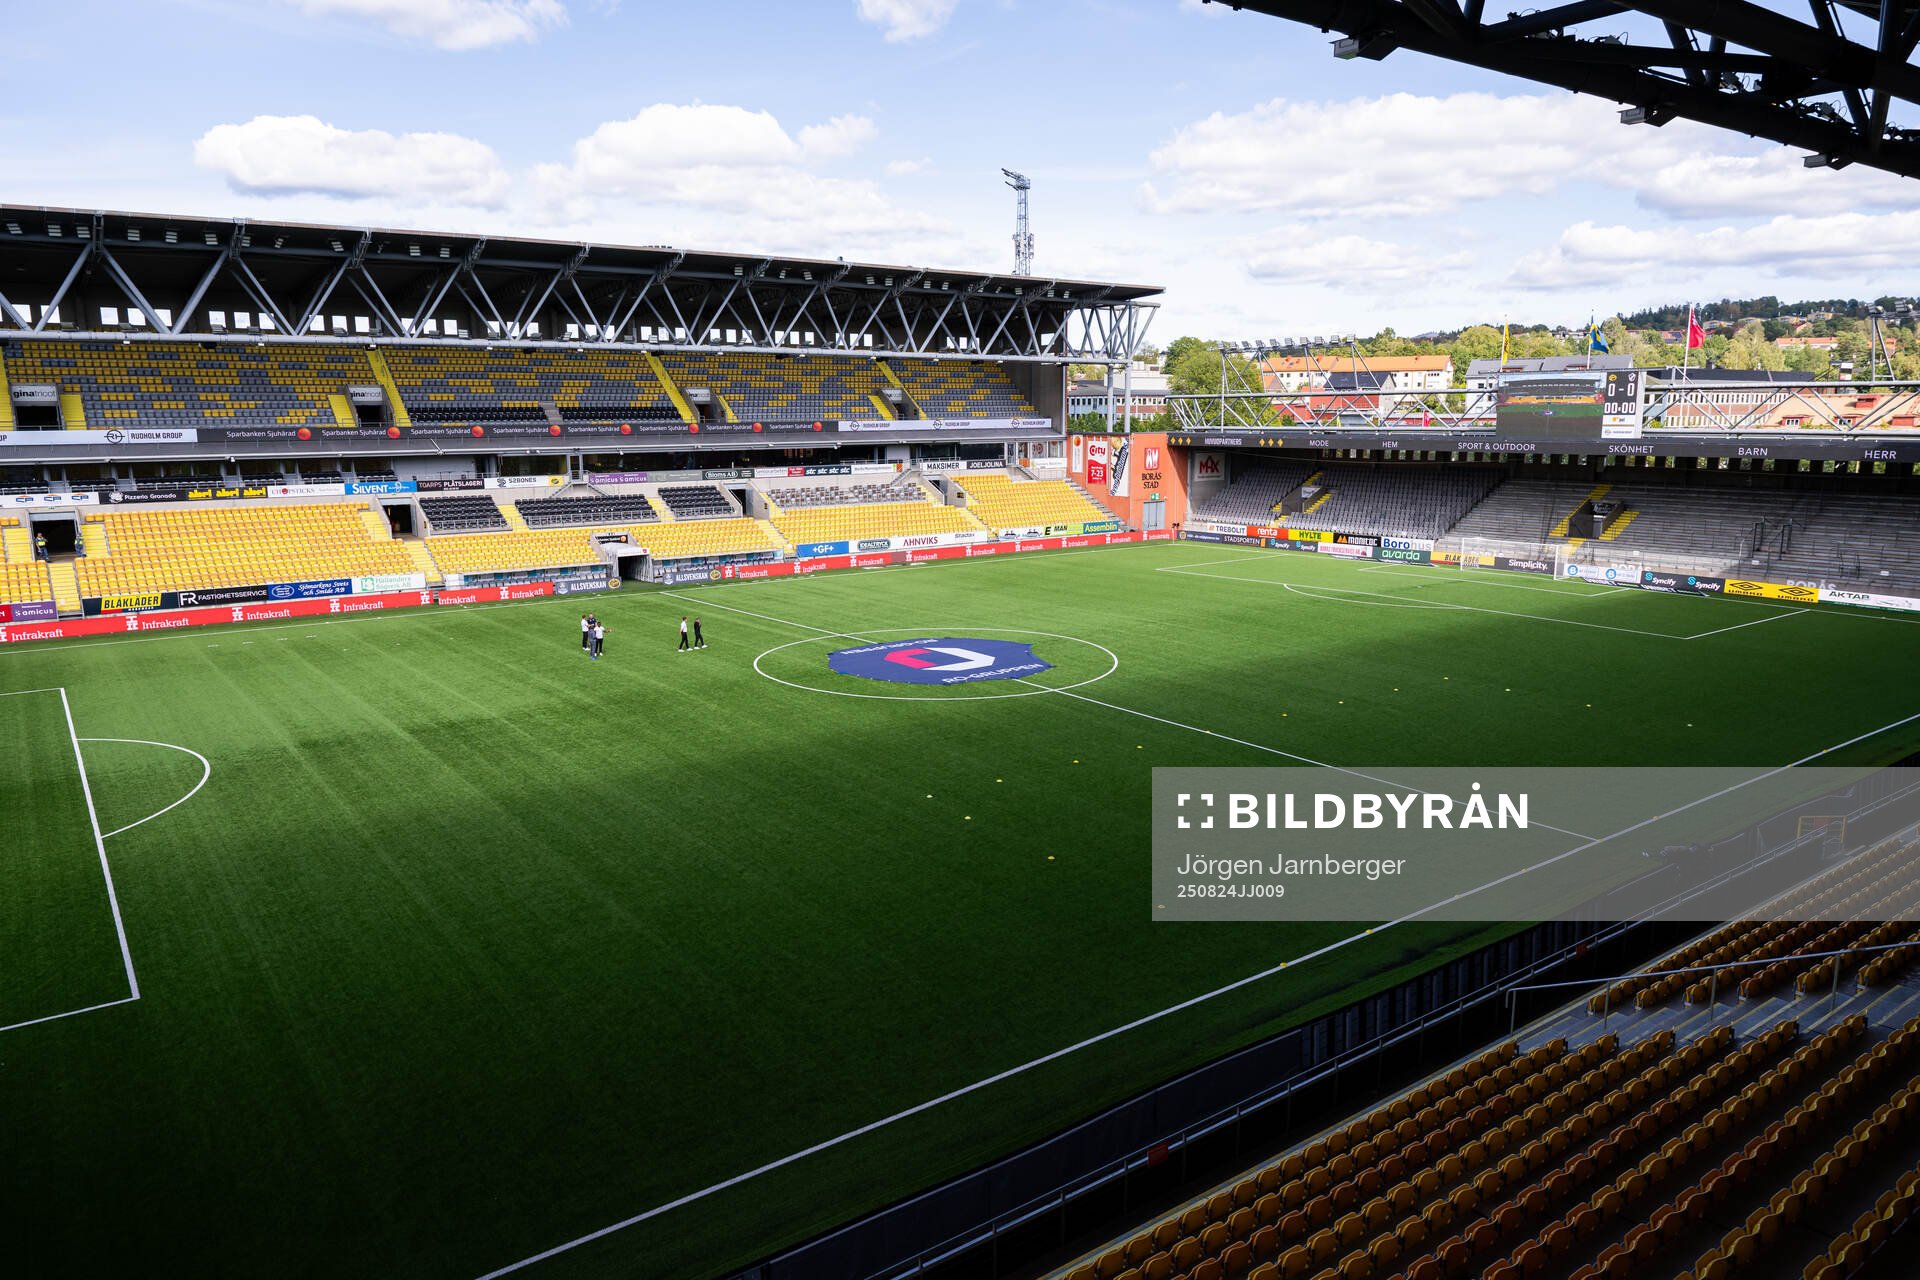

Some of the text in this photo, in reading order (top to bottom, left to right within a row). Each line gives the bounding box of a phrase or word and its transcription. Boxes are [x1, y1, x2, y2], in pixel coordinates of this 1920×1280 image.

[1608, 382, 1616, 396] 0
[1627, 382, 1634, 396] 0
[1604, 402, 1635, 414] 00:00
[1458, 442, 1482, 450] SPORT
[1493, 442, 1536, 451] OUTDOOR
[1608, 444, 1654, 454] SKÖNHET
[1738, 447, 1768, 456] BARN
[1864, 450, 1897, 459] HERR
[927, 462, 960, 470] MAKSIMER
[1142, 472, 1162, 480] BORÅS
[1085, 523, 1117, 532] Assemblin
[1257, 528, 1278, 536] renta
[1300, 531, 1322, 539] HYLTE
[904, 537, 938, 546] AHNVIKS
[1382, 550, 1420, 560] avarda
[1445, 554, 1480, 564] BLÅKÄDER
[676, 572, 708, 581] ALLSVENSKAN
[740, 570, 768, 578] Infrakraft
[571, 580, 606, 591] ALLSVENSKAN
[1652, 577, 1676, 586] Syncify
[1695, 582, 1720, 591] Syncify
[198, 590, 267, 600] FASTIGHETSSERVICE
[438, 596, 476, 605] Infrakraft
[344, 601, 383, 612] Infrakraft
[247, 608, 290, 621] Infrakraft
[142, 617, 189, 629] Infrakraft
[12, 628, 64, 640] Infrakraft
